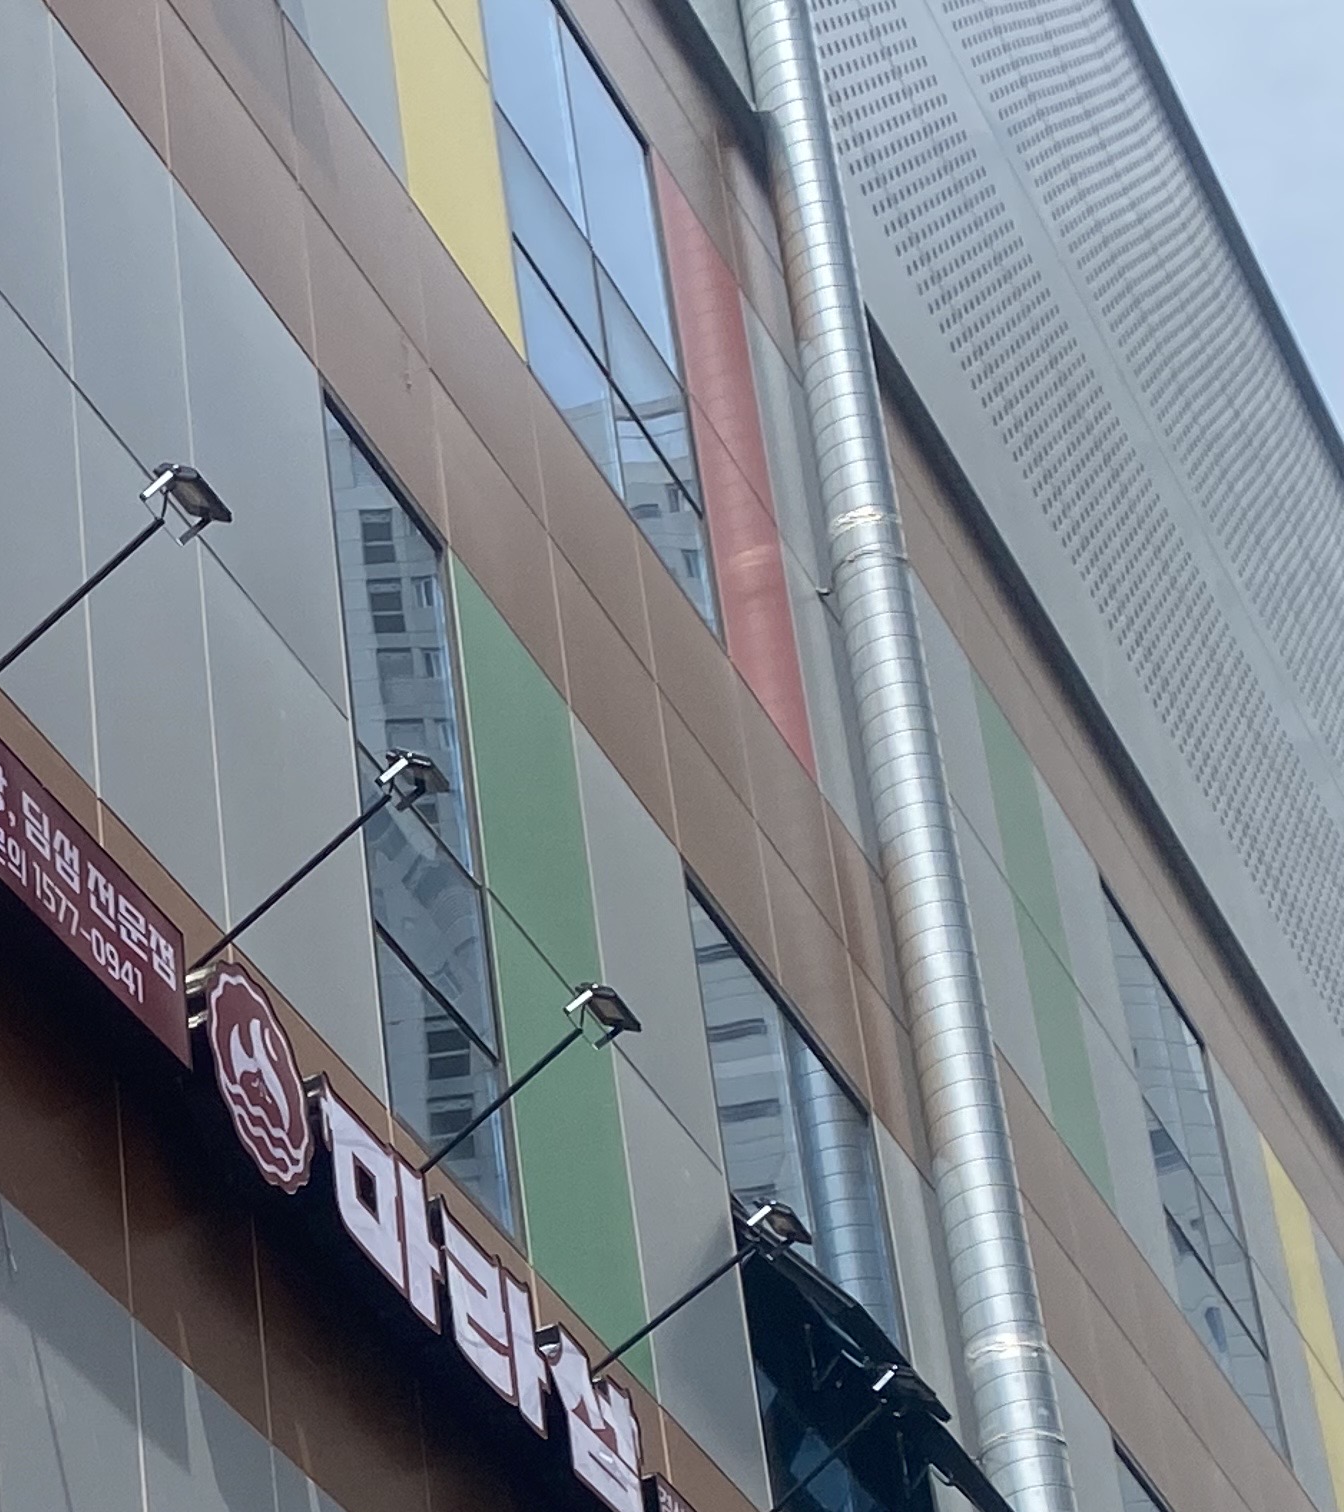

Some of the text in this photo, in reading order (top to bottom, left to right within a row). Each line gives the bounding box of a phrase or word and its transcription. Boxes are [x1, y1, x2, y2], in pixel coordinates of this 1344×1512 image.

[22, 791, 81, 894] 딤섬
[87, 862, 176, 991] 전문점
[33, 861, 144, 1003] 1577-0941
